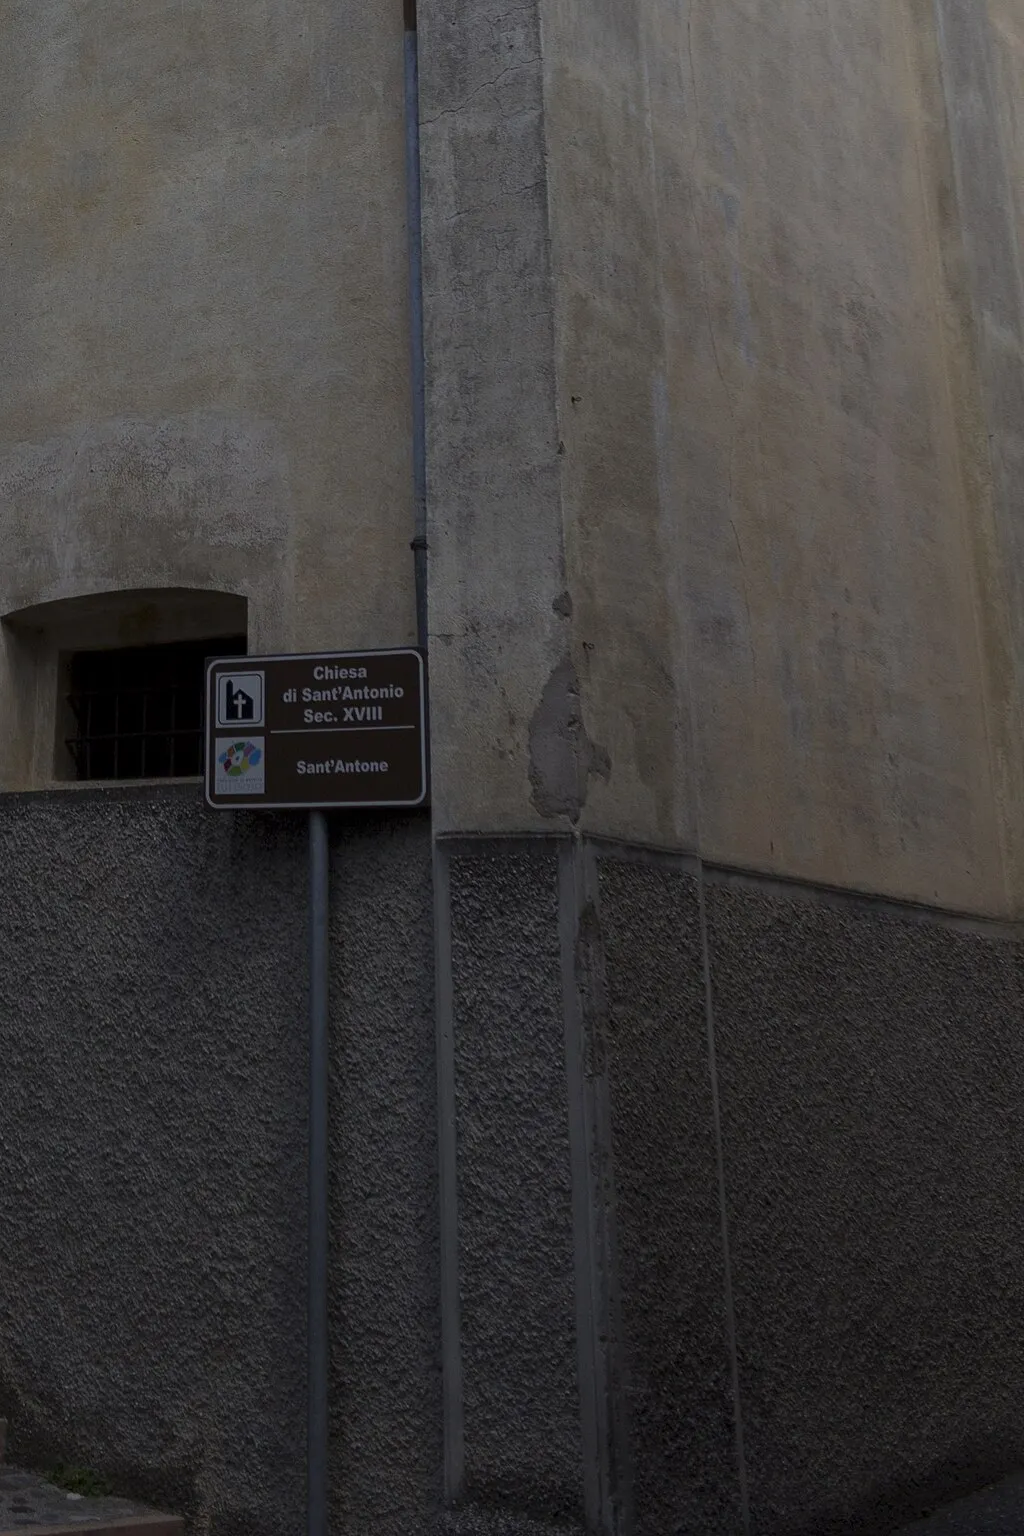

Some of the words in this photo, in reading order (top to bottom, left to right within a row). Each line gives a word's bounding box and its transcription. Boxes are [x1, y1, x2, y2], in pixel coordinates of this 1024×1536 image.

[313, 666, 368, 681] Chiesa
[283, 688, 297, 703] di
[302, 684, 404, 703] Sant'Antonio
[303, 708, 338, 724] Sec.
[343, 706, 383, 722] XVIII
[296, 759, 389, 775] Sant'Antone
